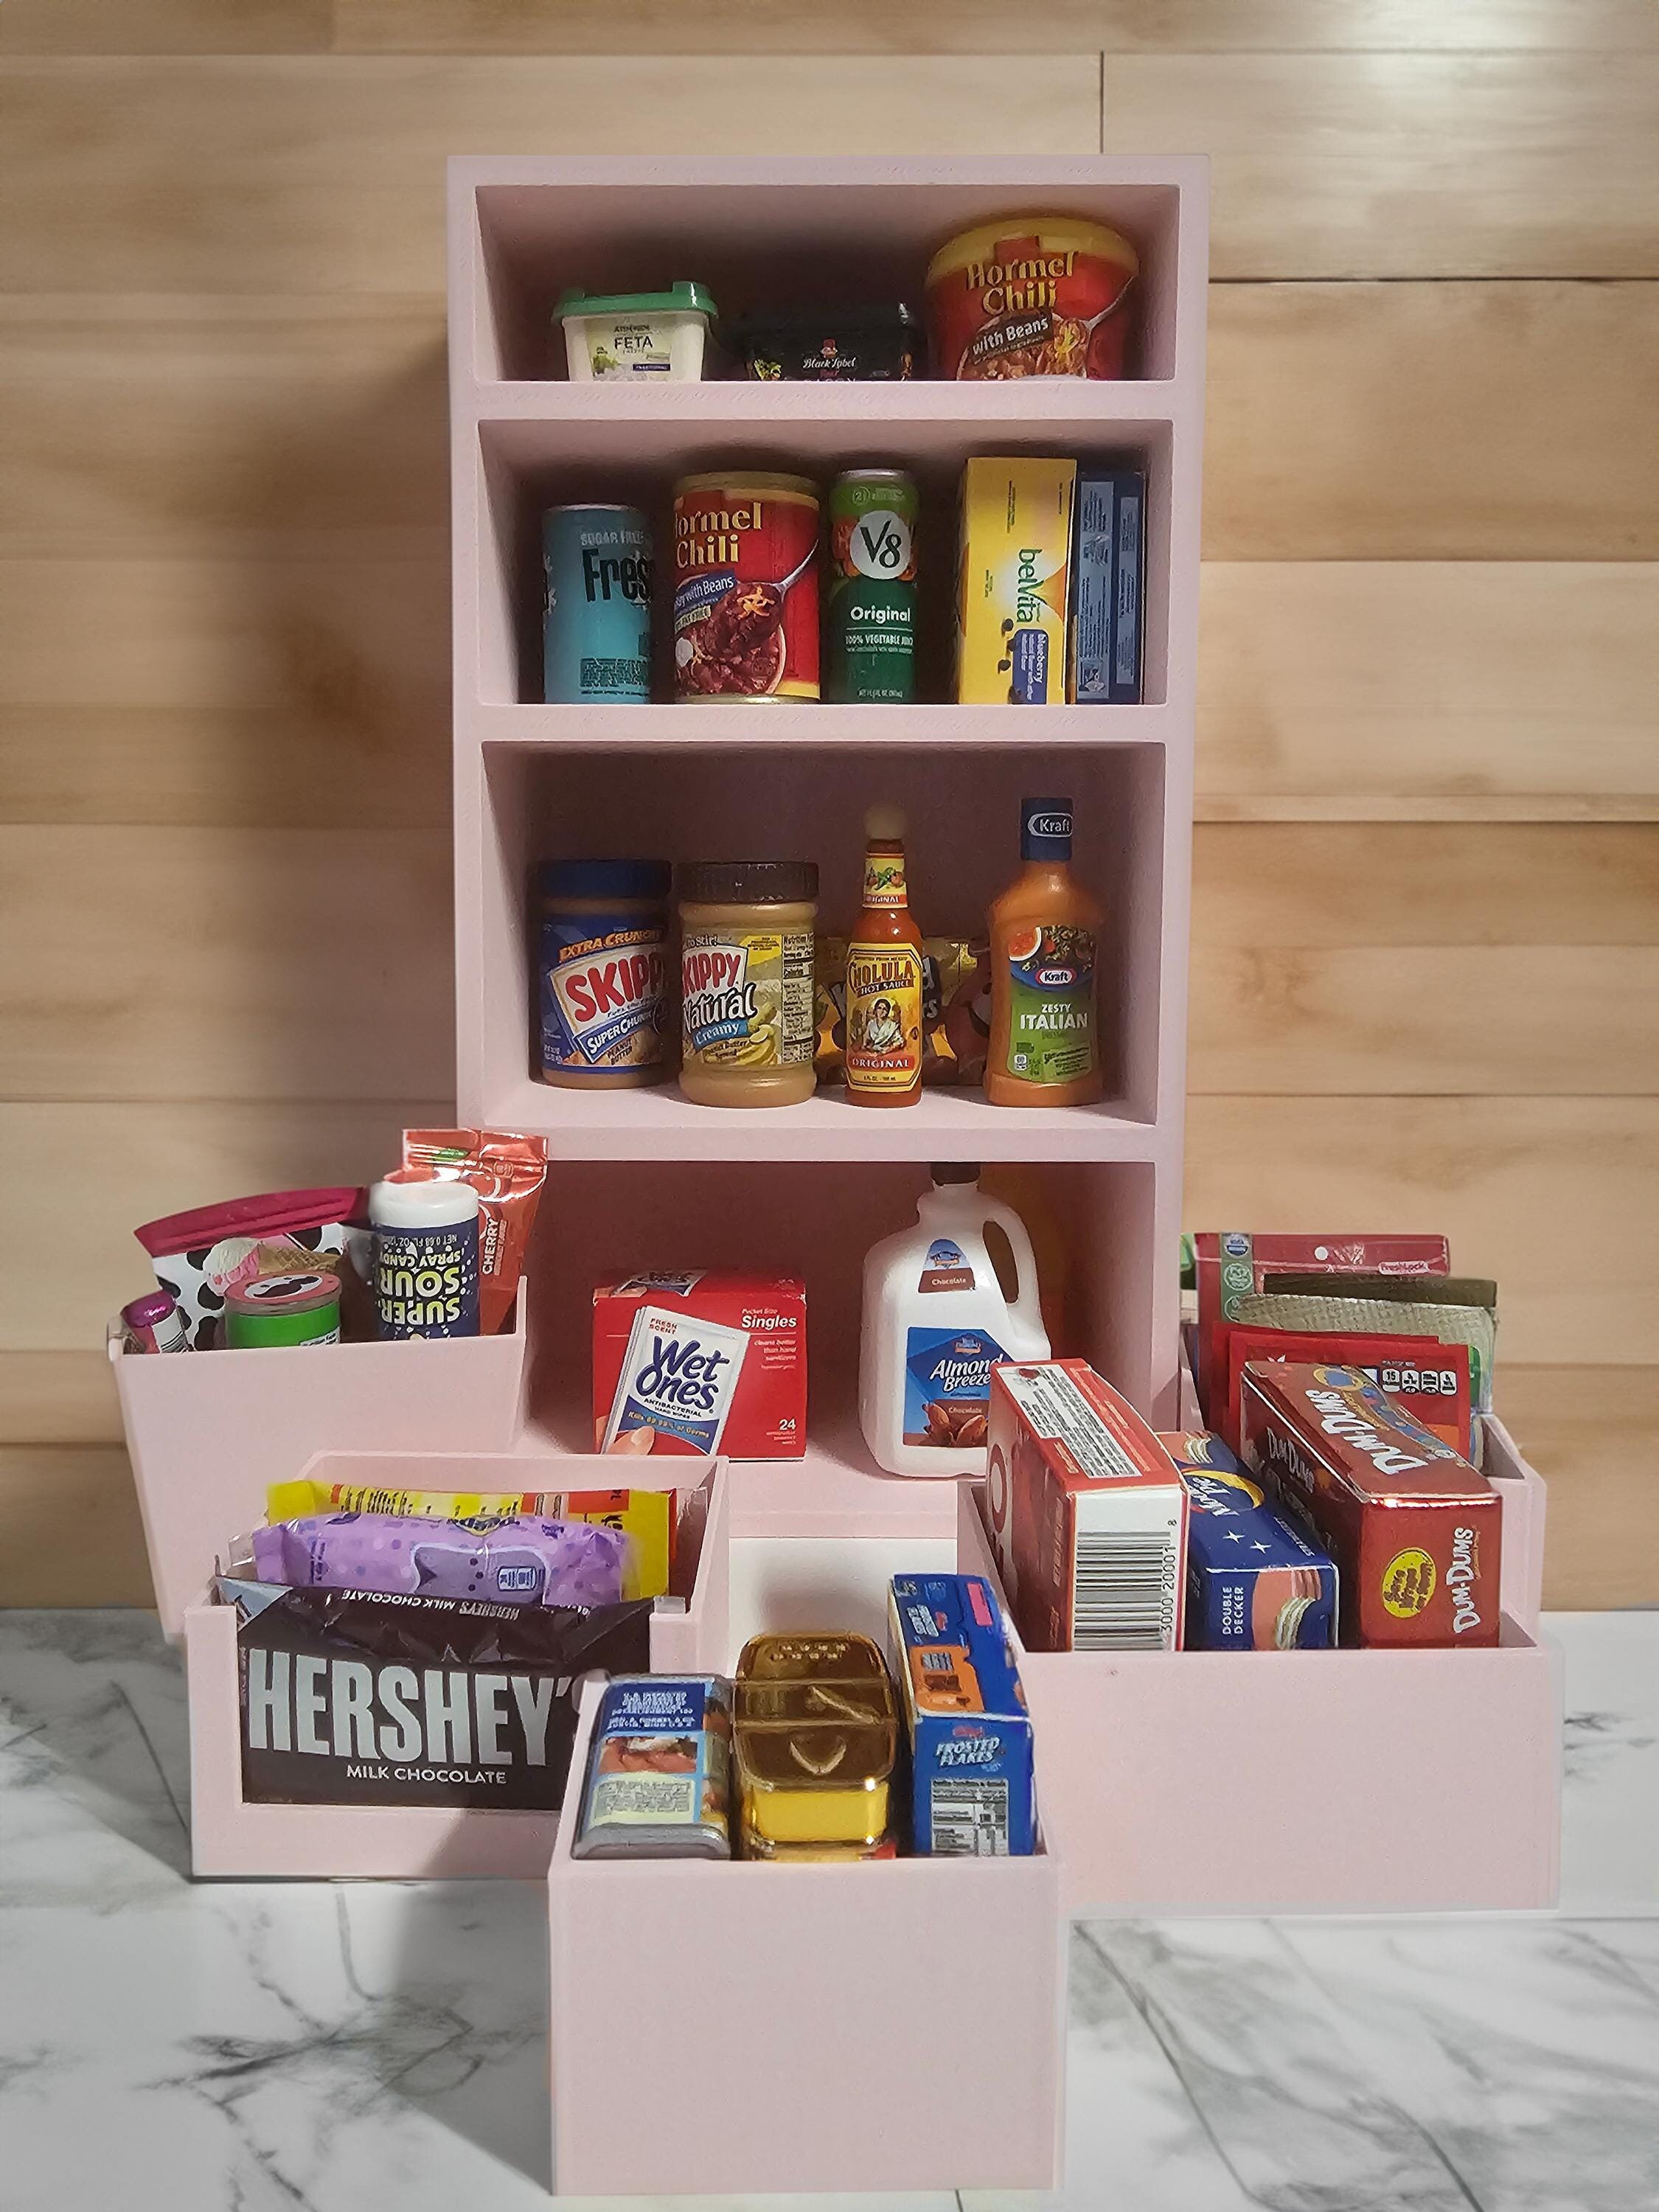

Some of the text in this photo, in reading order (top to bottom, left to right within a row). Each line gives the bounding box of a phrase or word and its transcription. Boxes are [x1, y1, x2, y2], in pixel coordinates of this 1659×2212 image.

[967, 251, 1079, 290] Hormel
[982, 281, 1058, 316] Chili
[613, 335, 653, 349] FETA
[972, 330, 1004, 355] with
[1005, 317, 1049, 341] Beans
[802, 357, 830, 369] Black
[676, 533, 740, 568] Chili
[860, 519, 902, 569] V8
[703, 577, 734, 596] Beans
[1015, 549, 1048, 624] belVita
[850, 605, 911, 625] Original
[1032, 633, 1046, 684] blueberry
[1039, 816, 1071, 833] Kraft
[557, 937, 602, 961] EXTRA
[848, 960, 915, 994] CHOLULA
[1044, 971, 1068, 982] Kraft
[860, 984, 880, 995] HOT
[1041, 1003, 1071, 1014] ZESTY
[1020, 1012, 1088, 1030] ITALIAN
[586, 1026, 621, 1054] SUPER
[695, 1023, 741, 1046] Creamy
[852, 1057, 909, 1068] ORIGINAL
[481, 1217, 498, 1275] CHERRY
[418, 1249, 462, 1268] SPRAY
[379, 1266, 461, 1298] SOUR
[380, 1296, 461, 1326] SUPER
[741, 1314, 797, 1331] Singles
[653, 1335, 731, 1382] Wet
[635, 1363, 720, 1411] Ones
[943, 1373, 992, 1392] Breeze
[644, 1398, 703, 1418] ANTIBACTERIAL
[779, 1418, 796, 1430] 24
[341, 1589, 422, 1607] CHOCOLATE
[424, 1599, 456, 1610] MILK
[1222, 1587, 1232, 1635] DOUBLE
[1234, 1587, 1245, 1635] DECKER
[935, 1736, 1001, 1756] FROSTED
[346, 1763, 507, 1785] MILK CHOCOLATE
